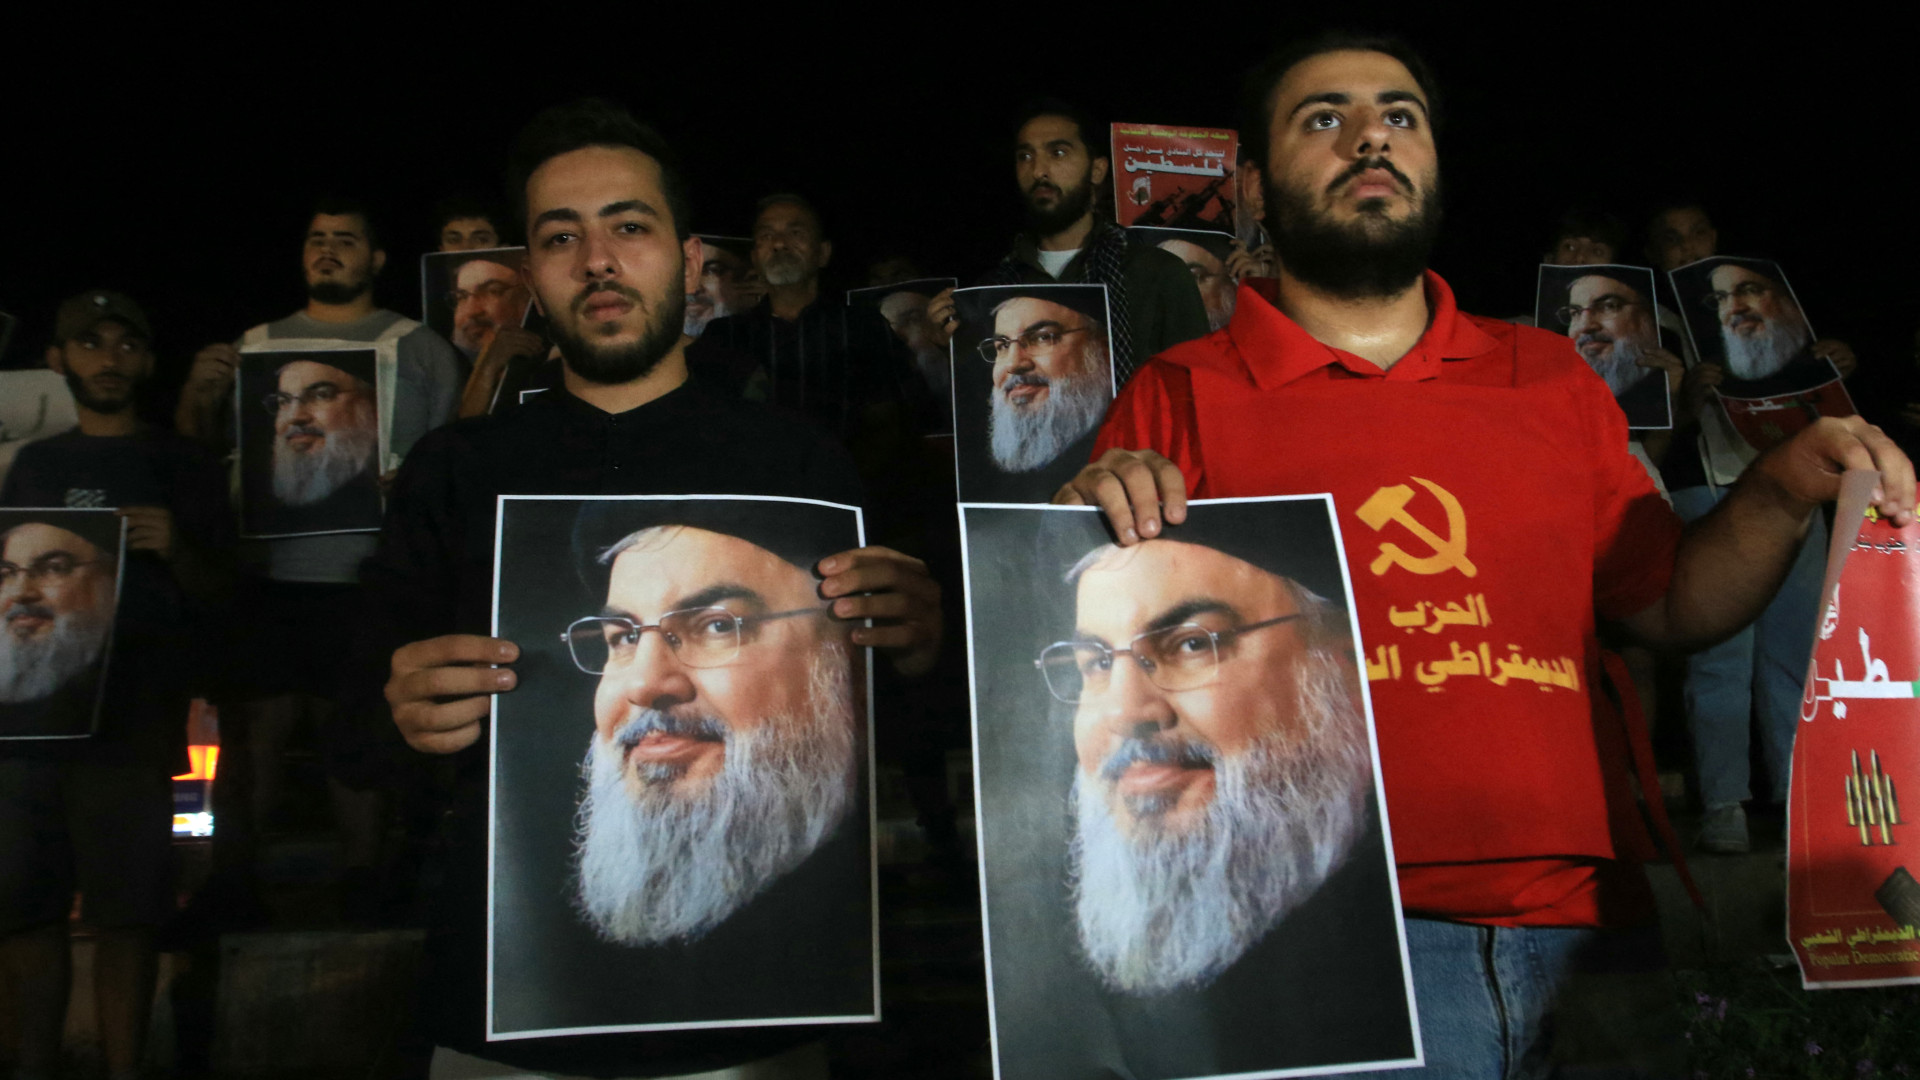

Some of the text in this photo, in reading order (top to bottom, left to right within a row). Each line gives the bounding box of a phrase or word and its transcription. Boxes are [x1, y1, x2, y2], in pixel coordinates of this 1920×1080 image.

[1125, 155, 1225, 177] فلسطين
[1389, 593, 1492, 634] الحزب
[1416, 641, 1580, 692] الديمقراطي
[1801, 924, 1915, 950] الديمقراطي الشعبي
[1808, 949, 1919, 970] Popular Democratic
